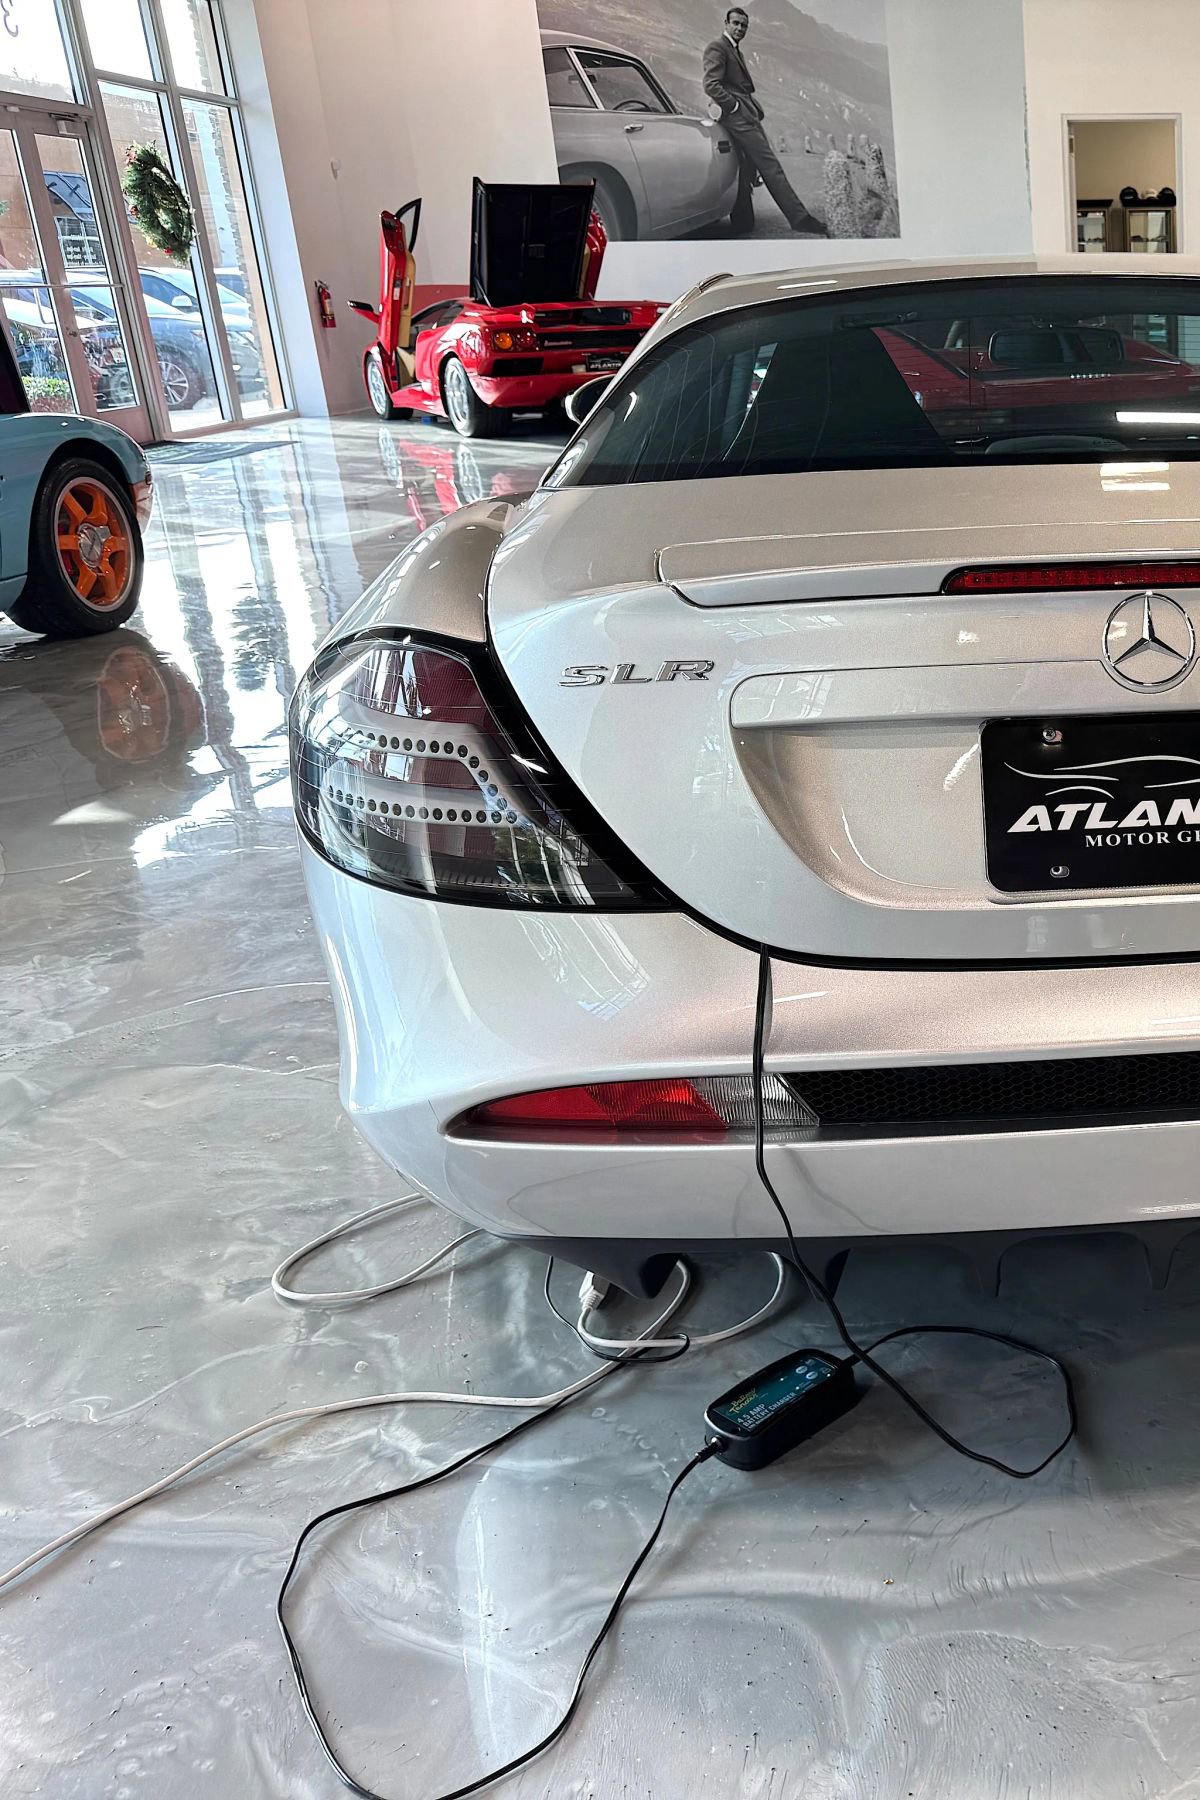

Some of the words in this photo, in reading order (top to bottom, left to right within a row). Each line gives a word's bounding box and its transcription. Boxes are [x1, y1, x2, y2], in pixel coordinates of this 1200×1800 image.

[558, 660, 715, 687] SLR
[1085, 831, 1170, 848] MOTOR
[743, 1409, 769, 1427] BATTERY
[768, 1392, 796, 1410] CHARGER
[749, 1403, 765, 1415] AMP
